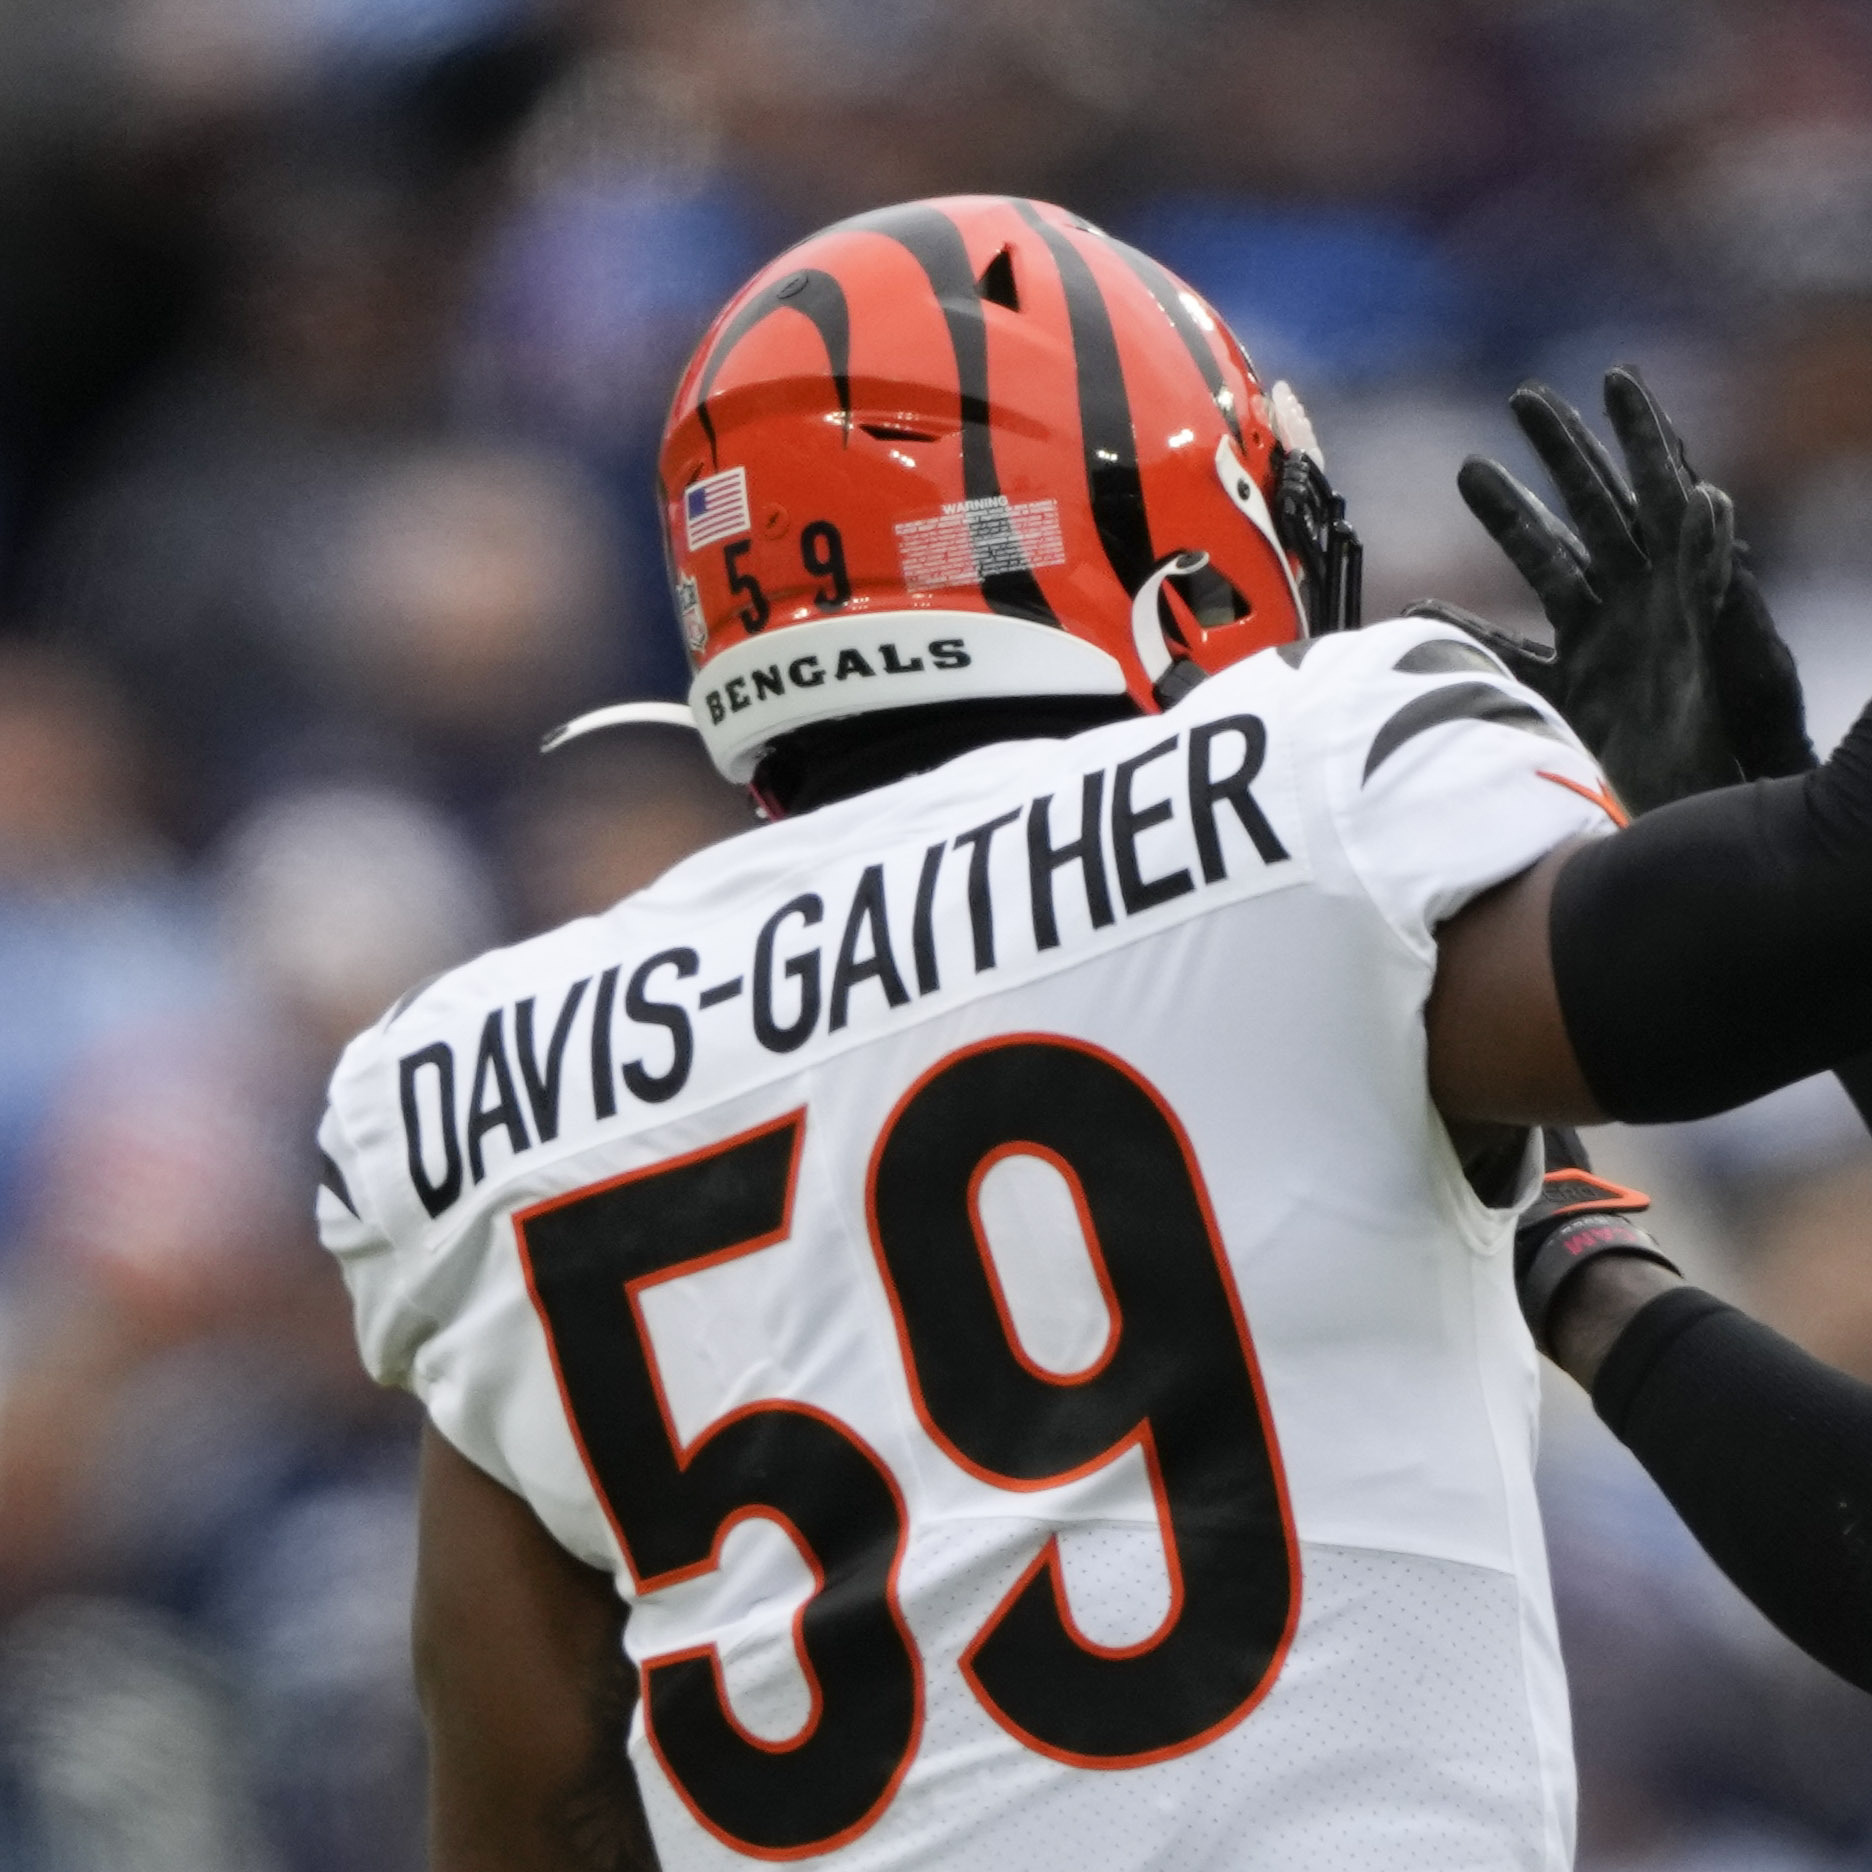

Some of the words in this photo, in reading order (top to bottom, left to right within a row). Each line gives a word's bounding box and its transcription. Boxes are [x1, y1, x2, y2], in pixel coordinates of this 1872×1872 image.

[941, 495, 1009, 515] WARNING
[705, 638, 972, 726] BENGALS
[399, 711, 1291, 1220] DAVIS-GAITHER
[512, 1031, 1303, 1862] 59
